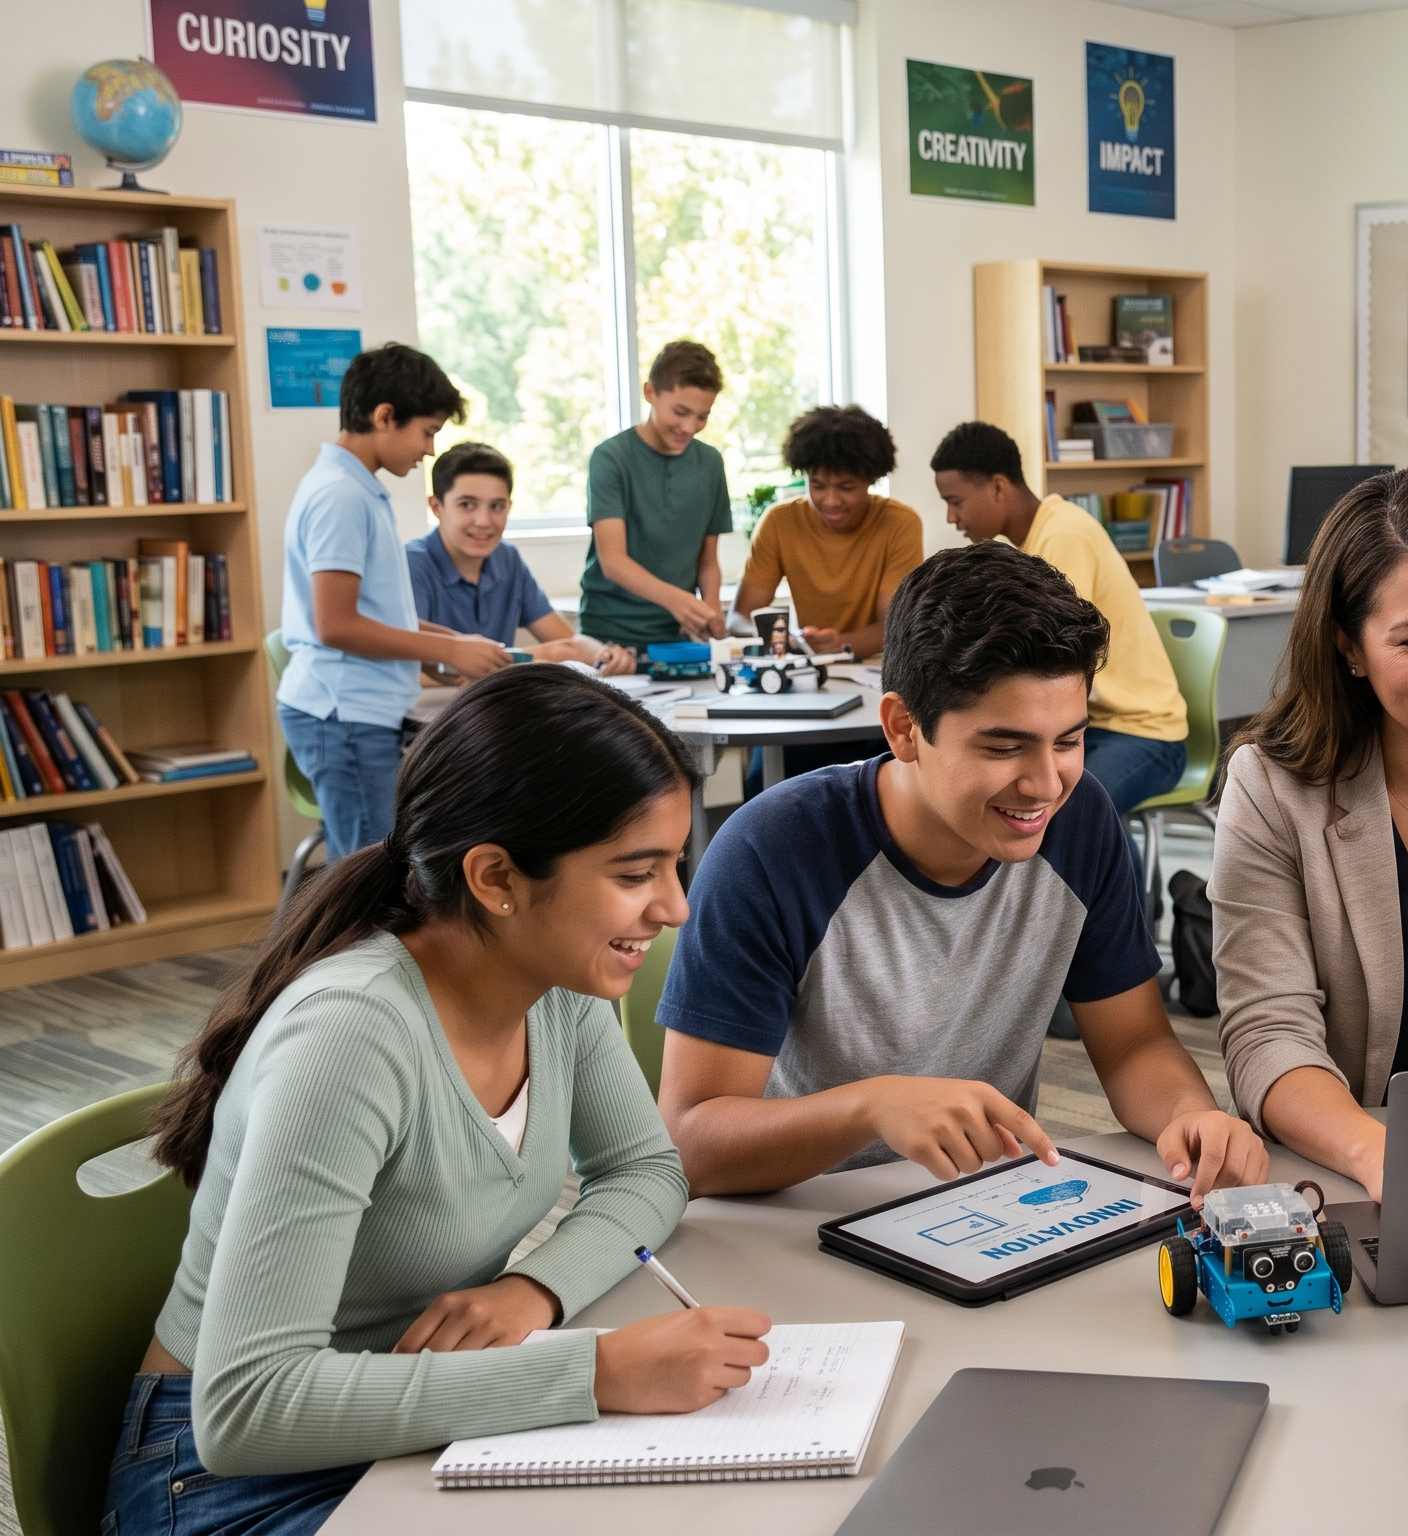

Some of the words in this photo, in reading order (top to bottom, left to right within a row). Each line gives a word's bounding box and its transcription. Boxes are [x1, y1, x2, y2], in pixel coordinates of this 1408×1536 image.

[177, 12, 350, 71] CURIOSITY
[918, 129, 1026, 171] CREATIVITY
[1099, 140, 1164, 176] IMPACT
[979, 1198, 1144, 1261] INNOVATION
